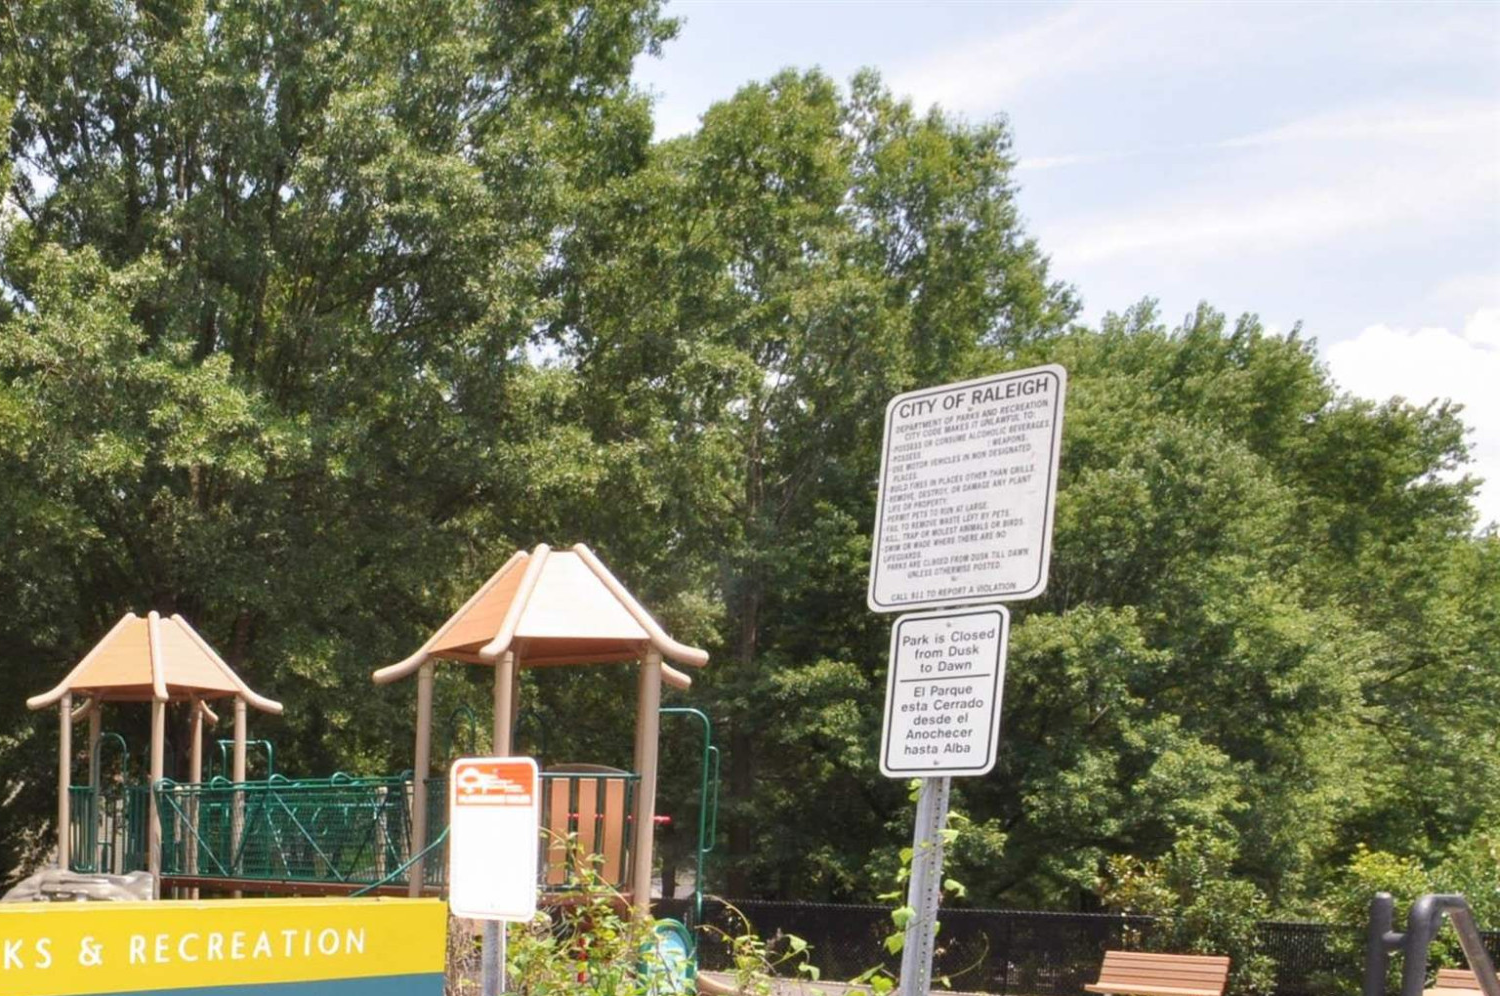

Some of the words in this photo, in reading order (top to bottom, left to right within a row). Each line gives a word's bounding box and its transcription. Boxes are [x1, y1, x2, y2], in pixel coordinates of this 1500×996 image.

[899, 398, 937, 418] CITY
[942, 392, 965, 410] OF
[971, 377, 1048, 405] RALEIGH
[895, 418, 941, 433] DEPARTMENT
[943, 416, 953, 425] OF
[955, 411, 979, 422] PARKS
[982, 408, 997, 418] AND
[999, 399, 1047, 414] RECREATION
[904, 431, 920, 441] CITY
[922, 427, 941, 437] CODE
[944, 422, 969, 433] MAKES
[970, 420, 978, 429] IT
[980, 413, 1019, 427] UNLAWFUL
[891, 593, 908, 601] CALL
[926, 590, 936, 598] TO
[938, 587, 965, 597] REPORT
[968, 586, 973, 594] A
[976, 582, 1016, 593] VIOLATION
[902, 634, 929, 647] Park
[934, 633, 945, 644] is
[950, 628, 995, 643] Closed
[914, 650, 943, 660] from
[948, 644, 979, 657] Dusk
[920, 663, 932, 673] to
[937, 660, 972, 672] Dawn
[913, 686, 925, 697] El
[930, 685, 973, 697] Parque
[901, 701, 928, 712] esta
[933, 698, 984, 710] Cerrado
[913, 714, 951, 726] desde
[957, 713, 968, 723] el
[906, 727, 973, 740] Anochecer
[904, 743, 938, 755] hasta
[943, 742, 971, 753] Alba
[78, 935, 103, 967] &
[129, 927, 366, 964] RECREATION
